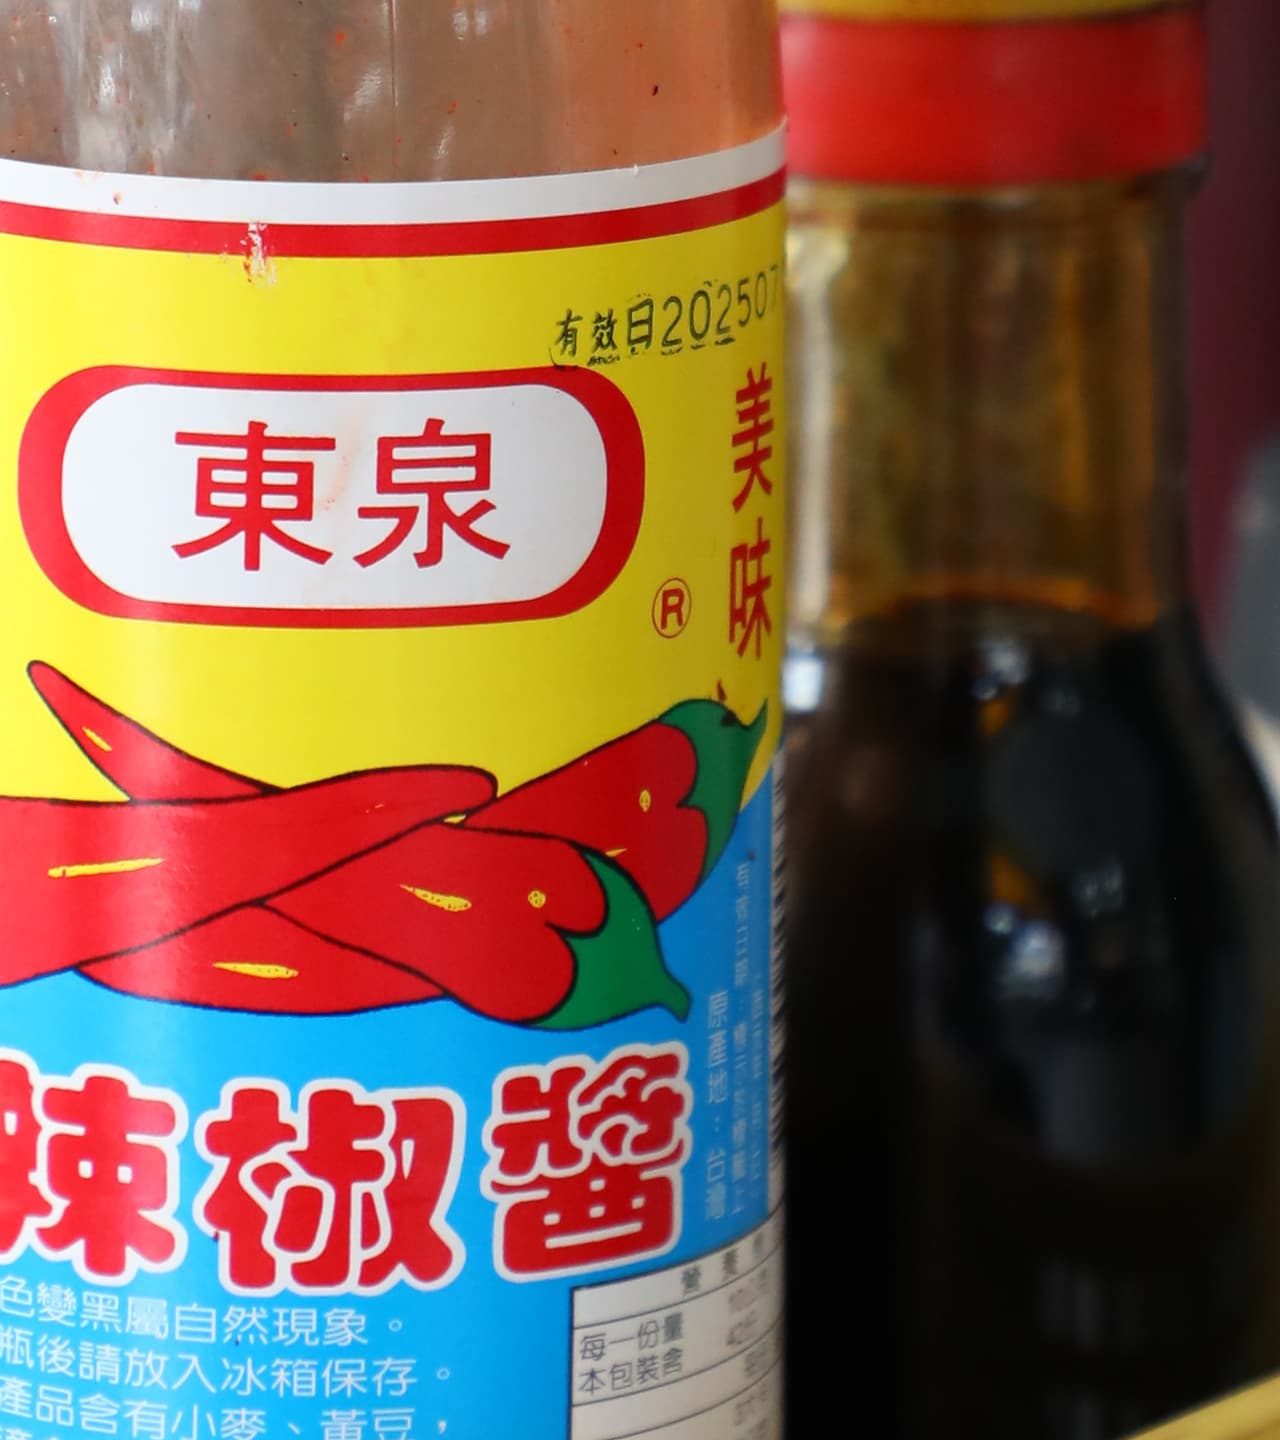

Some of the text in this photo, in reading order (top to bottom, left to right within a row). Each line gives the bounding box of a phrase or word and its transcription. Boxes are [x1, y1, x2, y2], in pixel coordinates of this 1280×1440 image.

[170, 417, 511, 571] 東泉
[727, 361, 775, 661] 美味
[579, 1347, 684, 1397] 本包裝含
[580, 1311, 684, 1362] 每一份量
